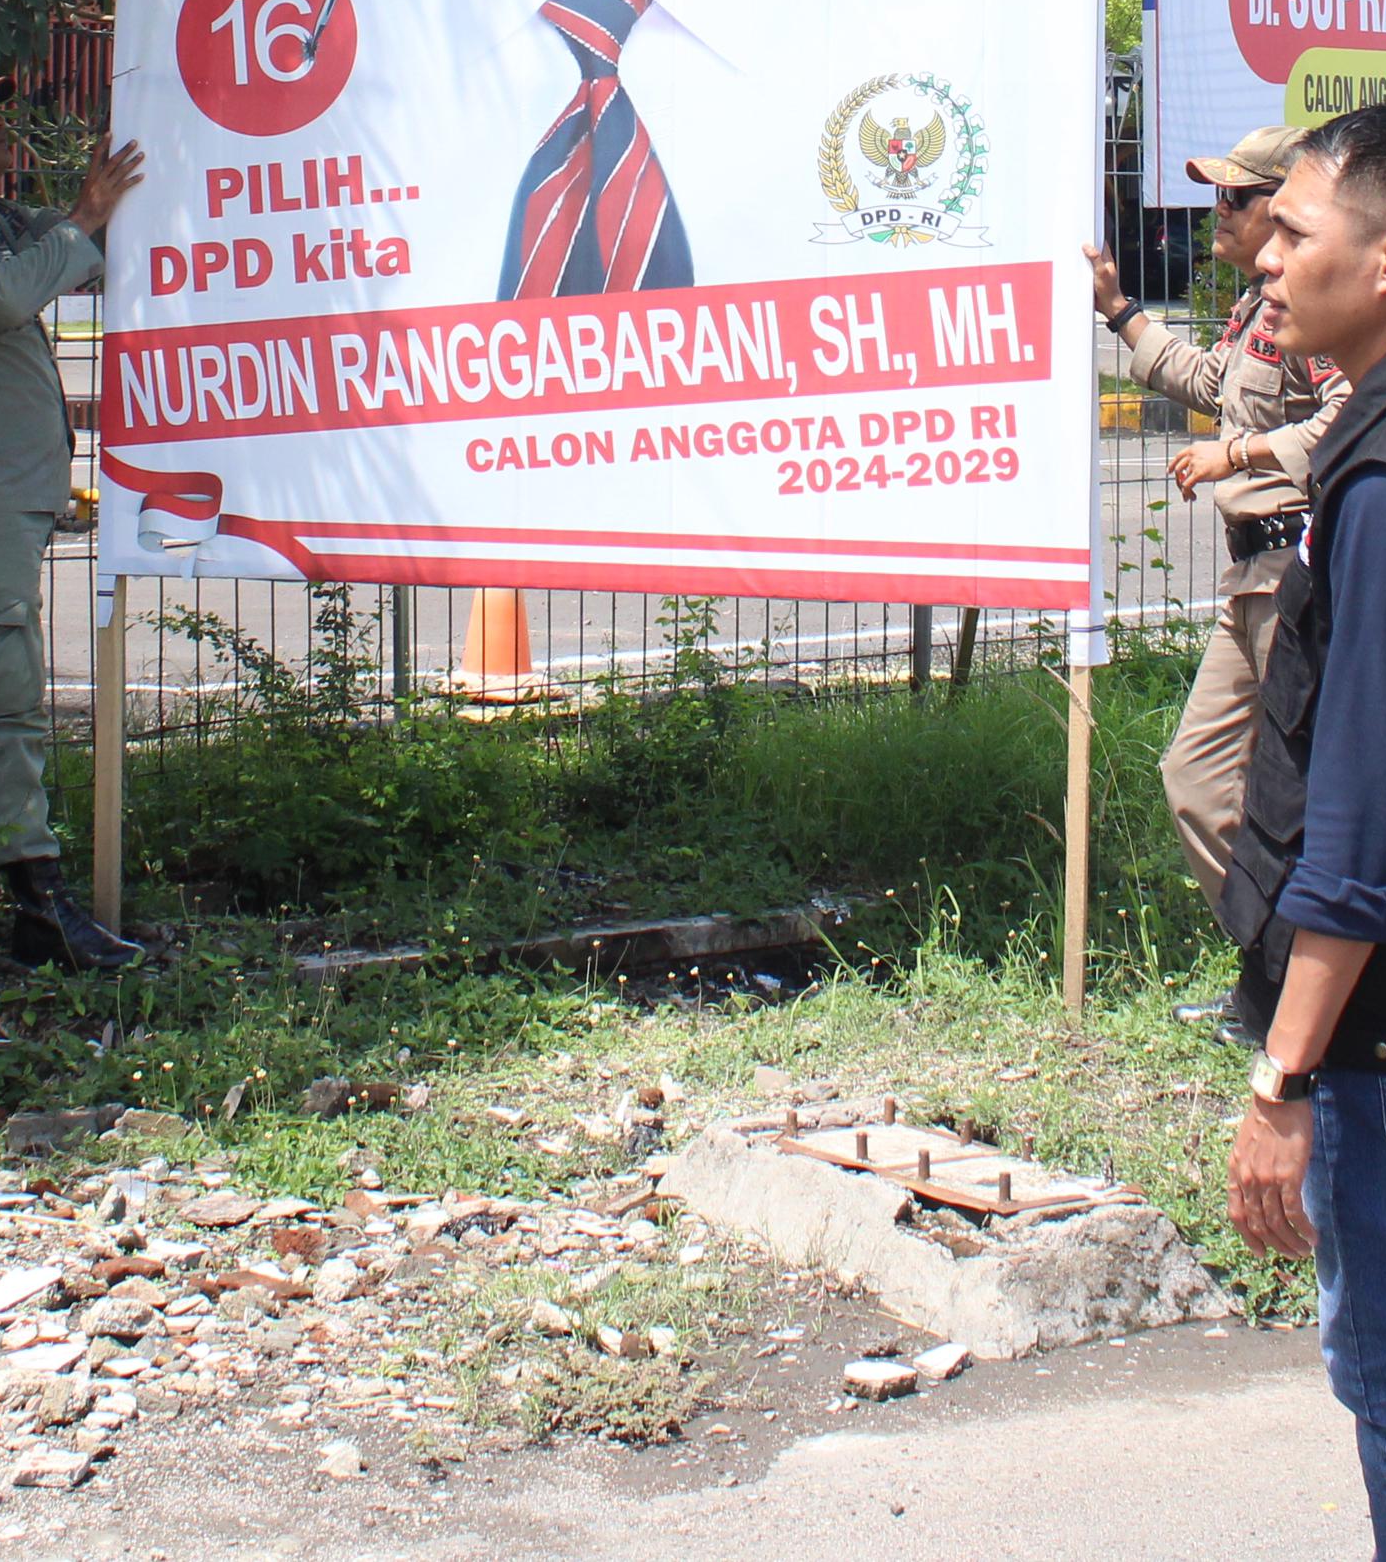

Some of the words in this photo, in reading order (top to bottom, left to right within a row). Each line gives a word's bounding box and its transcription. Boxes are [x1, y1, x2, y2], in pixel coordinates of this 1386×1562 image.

[1303, 73, 1354, 114] CALON
[205, 154, 421, 219] PILIH...
[150, 237, 274, 297] DPD
[292, 228, 412, 284] kita
[118, 336, 320, 429] NURDIN
[329, 299, 799, 412] RANGGABARANI,
[809, 291, 919, 387] SH.,
[928, 282, 1036, 369] MH.
[465, 430, 616, 474] CALON
[629, 415, 846, 463] ANGGOTA
[858, 407, 957, 449] DPD
[970, 404, 1018, 440] RI
[776, 446, 1022, 495] 2024-2029
